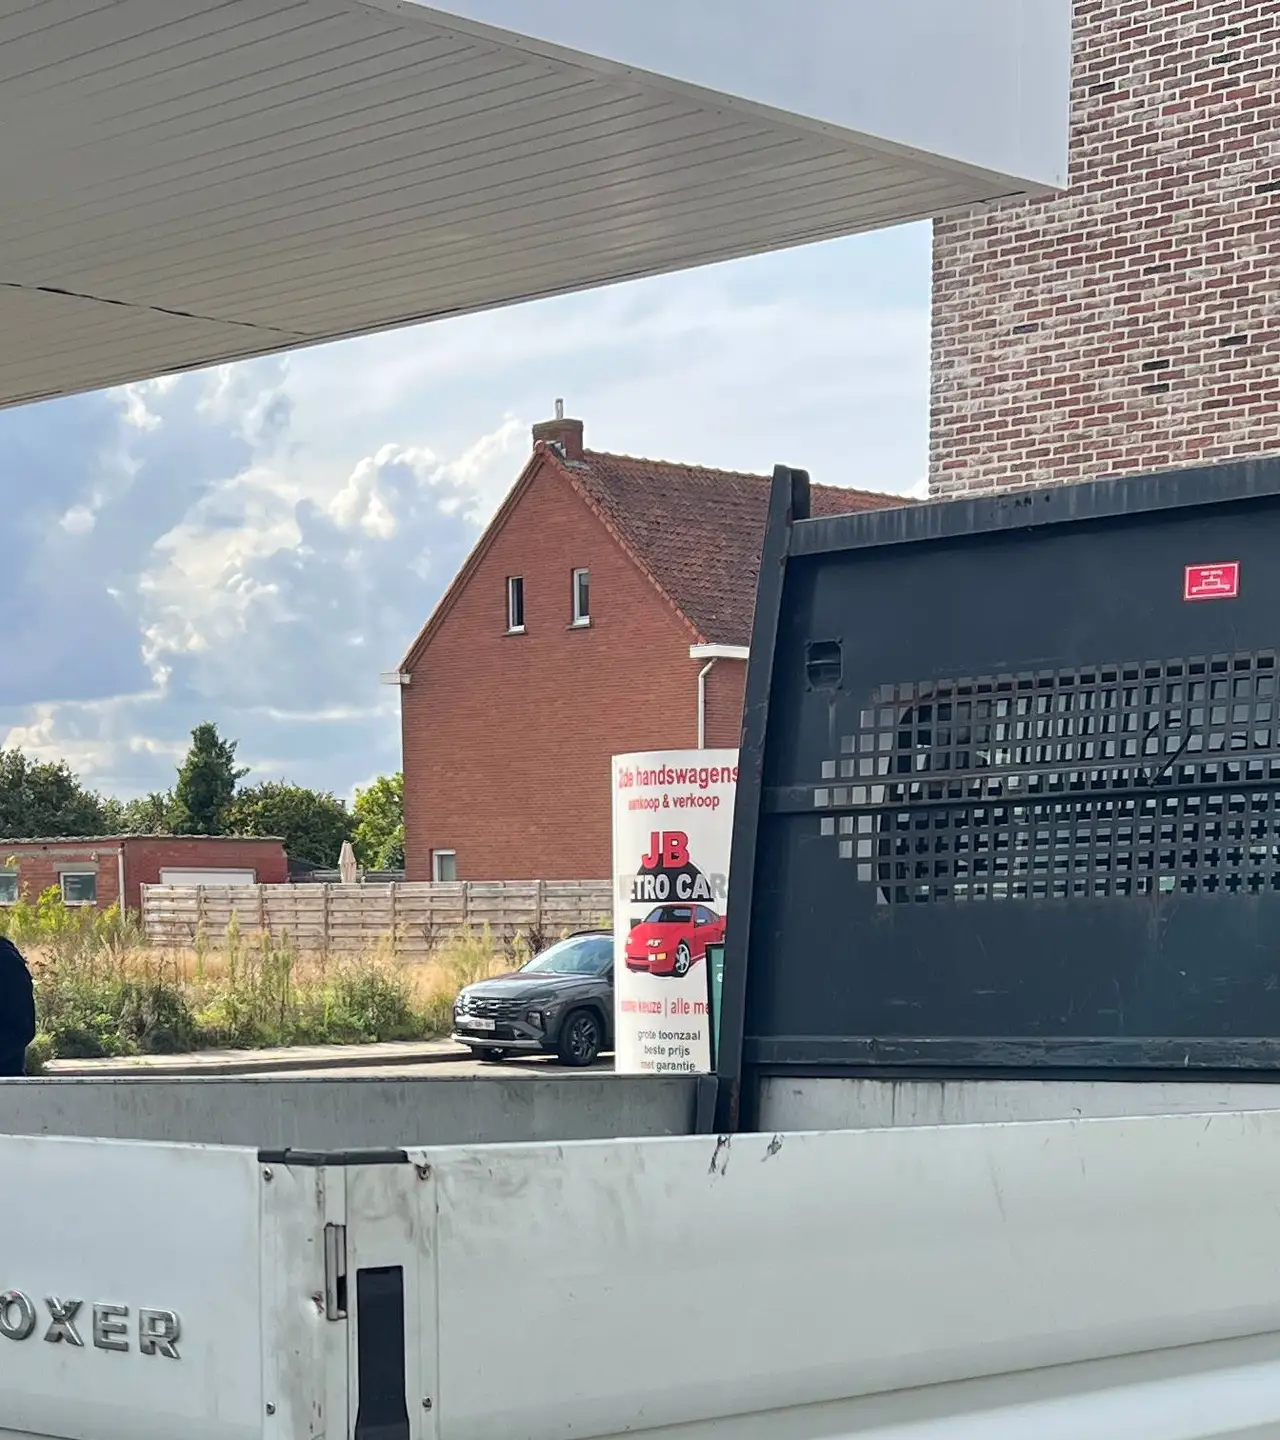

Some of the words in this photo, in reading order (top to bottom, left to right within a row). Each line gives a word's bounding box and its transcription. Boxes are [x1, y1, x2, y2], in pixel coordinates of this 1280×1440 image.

[636, 764, 739, 789] handswagens
[663, 793, 670, 809] &
[672, 792, 720, 811] verkoop
[641, 831, 689, 869] JB
[620, 873, 670, 901] ETRO
[671, 998, 690, 1015] alle
[658, 1030, 701, 1041] toonzaal
[644, 1044, 666, 1055] beste
[668, 1045, 691, 1058] prijs
[656, 1061, 696, 1073] garantie
